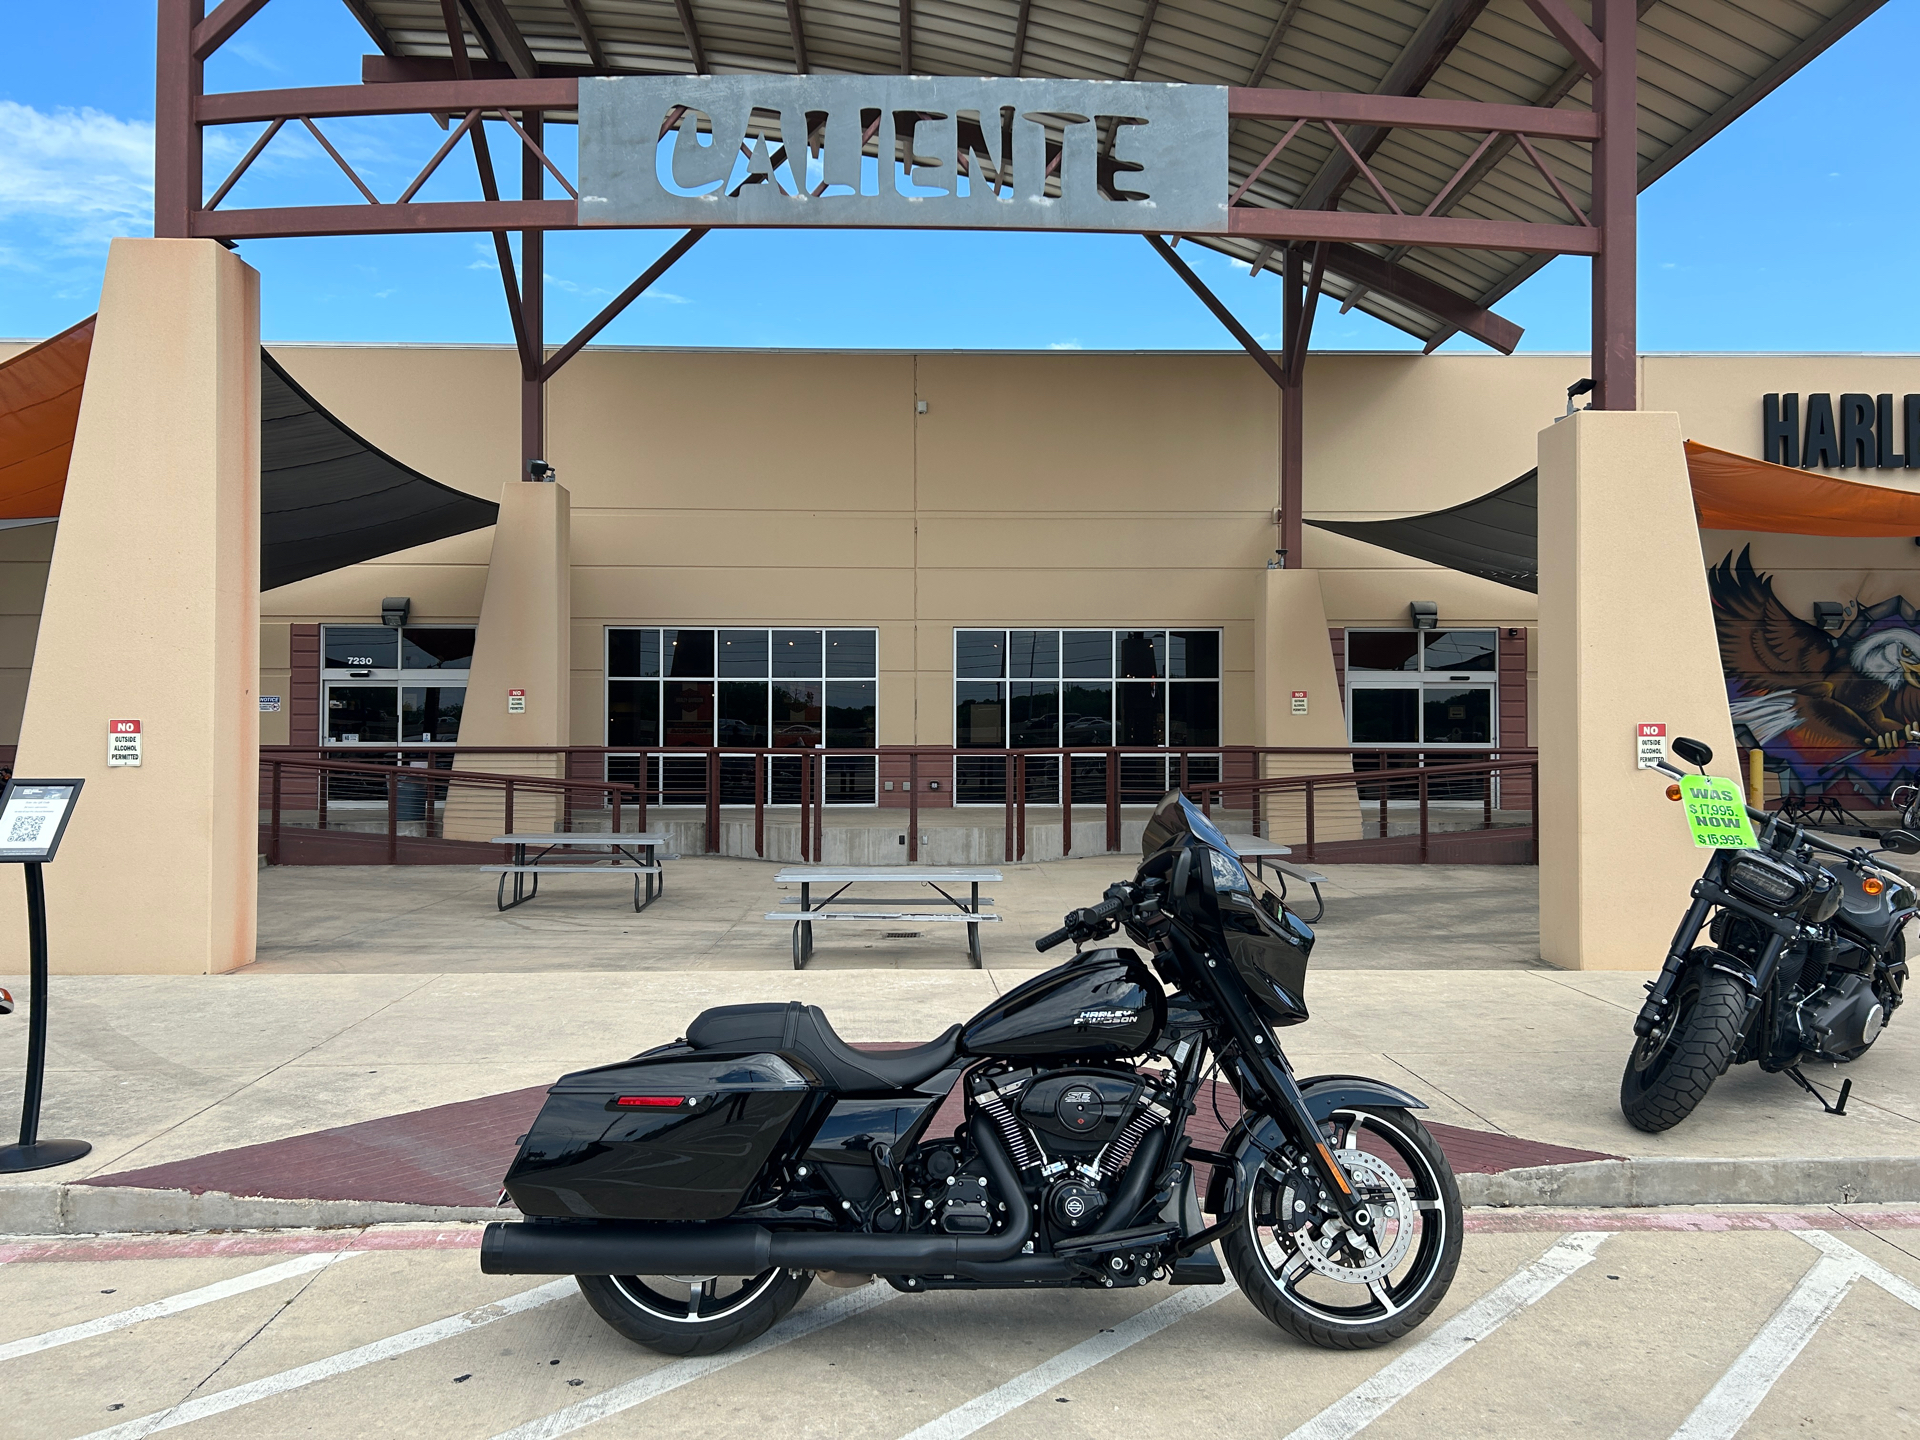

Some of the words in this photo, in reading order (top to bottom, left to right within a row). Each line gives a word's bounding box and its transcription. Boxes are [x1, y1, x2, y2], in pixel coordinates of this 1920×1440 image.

[655, 104, 1150, 202] CALIENTE
[347, 657, 373, 665] 7230
[117, 722, 135, 732] NO
[1643, 726, 1659, 735] NO
[1689, 787, 1733, 802] WAS
[1695, 815, 1741, 829] NOW
